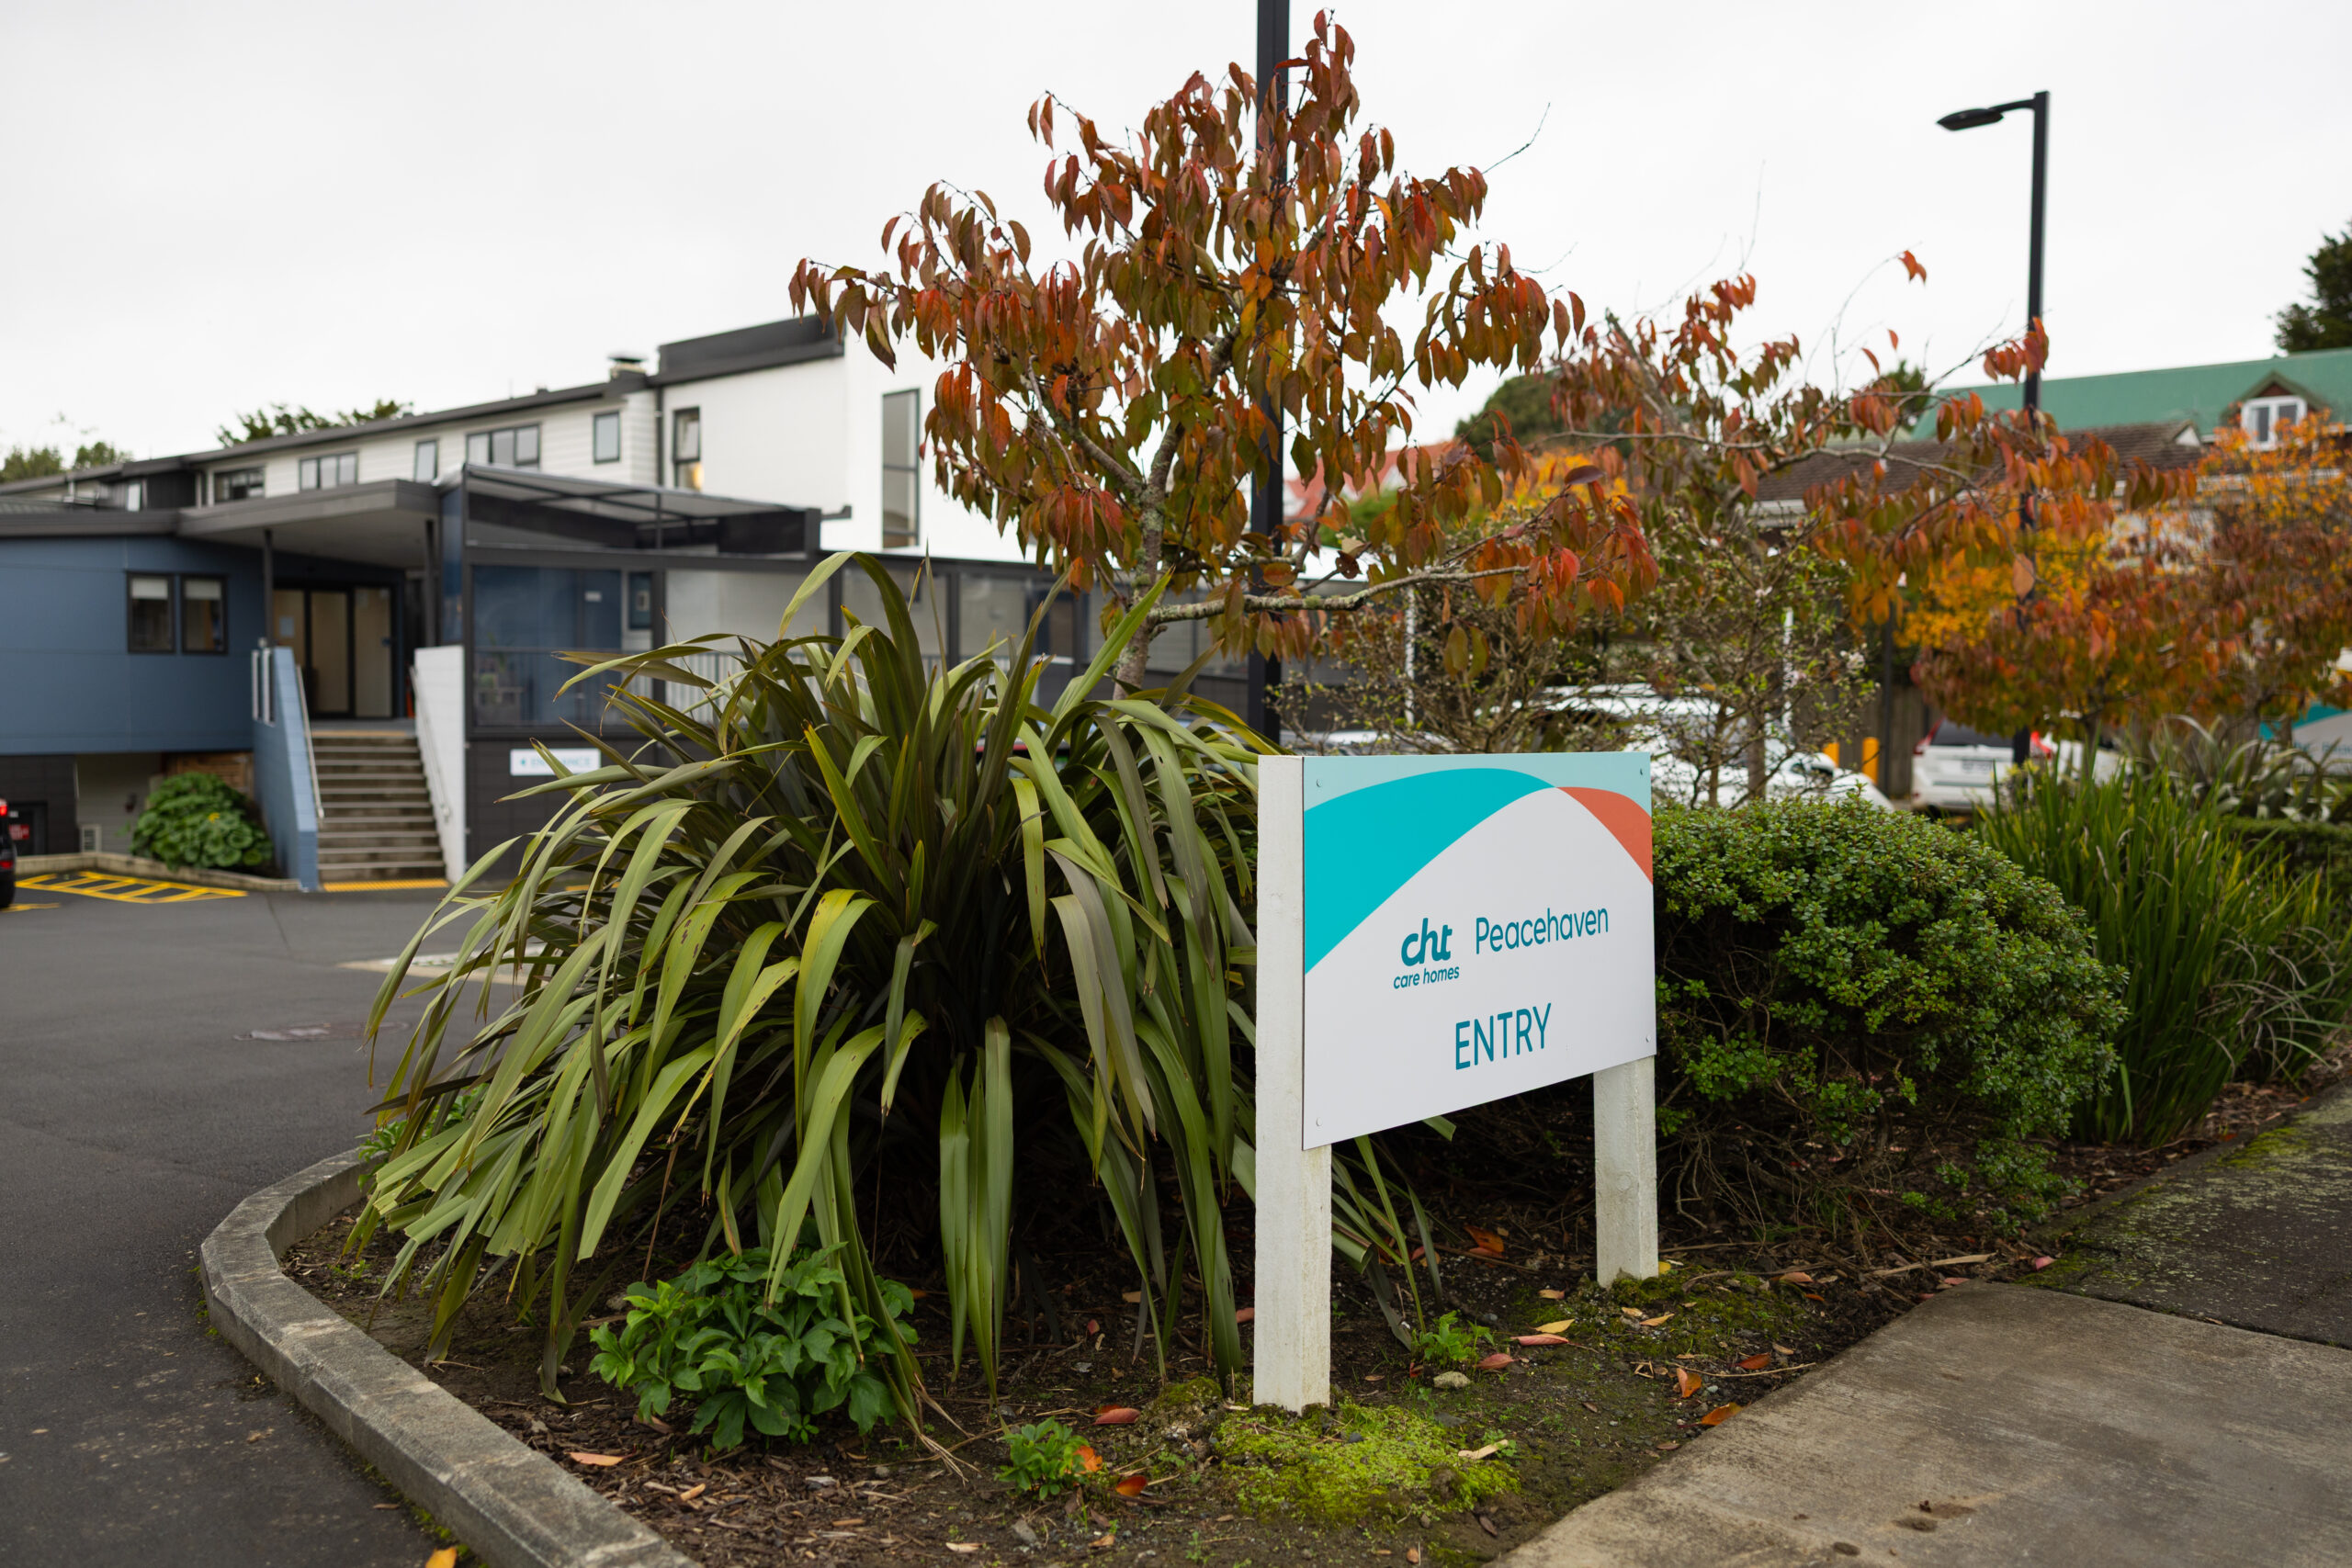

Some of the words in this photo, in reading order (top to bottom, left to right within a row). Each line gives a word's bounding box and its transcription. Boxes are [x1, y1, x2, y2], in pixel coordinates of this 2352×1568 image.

[1401, 917, 1453, 967] cht
[1476, 907, 1609, 955] Peacehaven
[1393, 972, 1420, 989] care
[1422, 965, 1460, 985] homes
[1454, 1002, 1552, 1071] ENTRY
